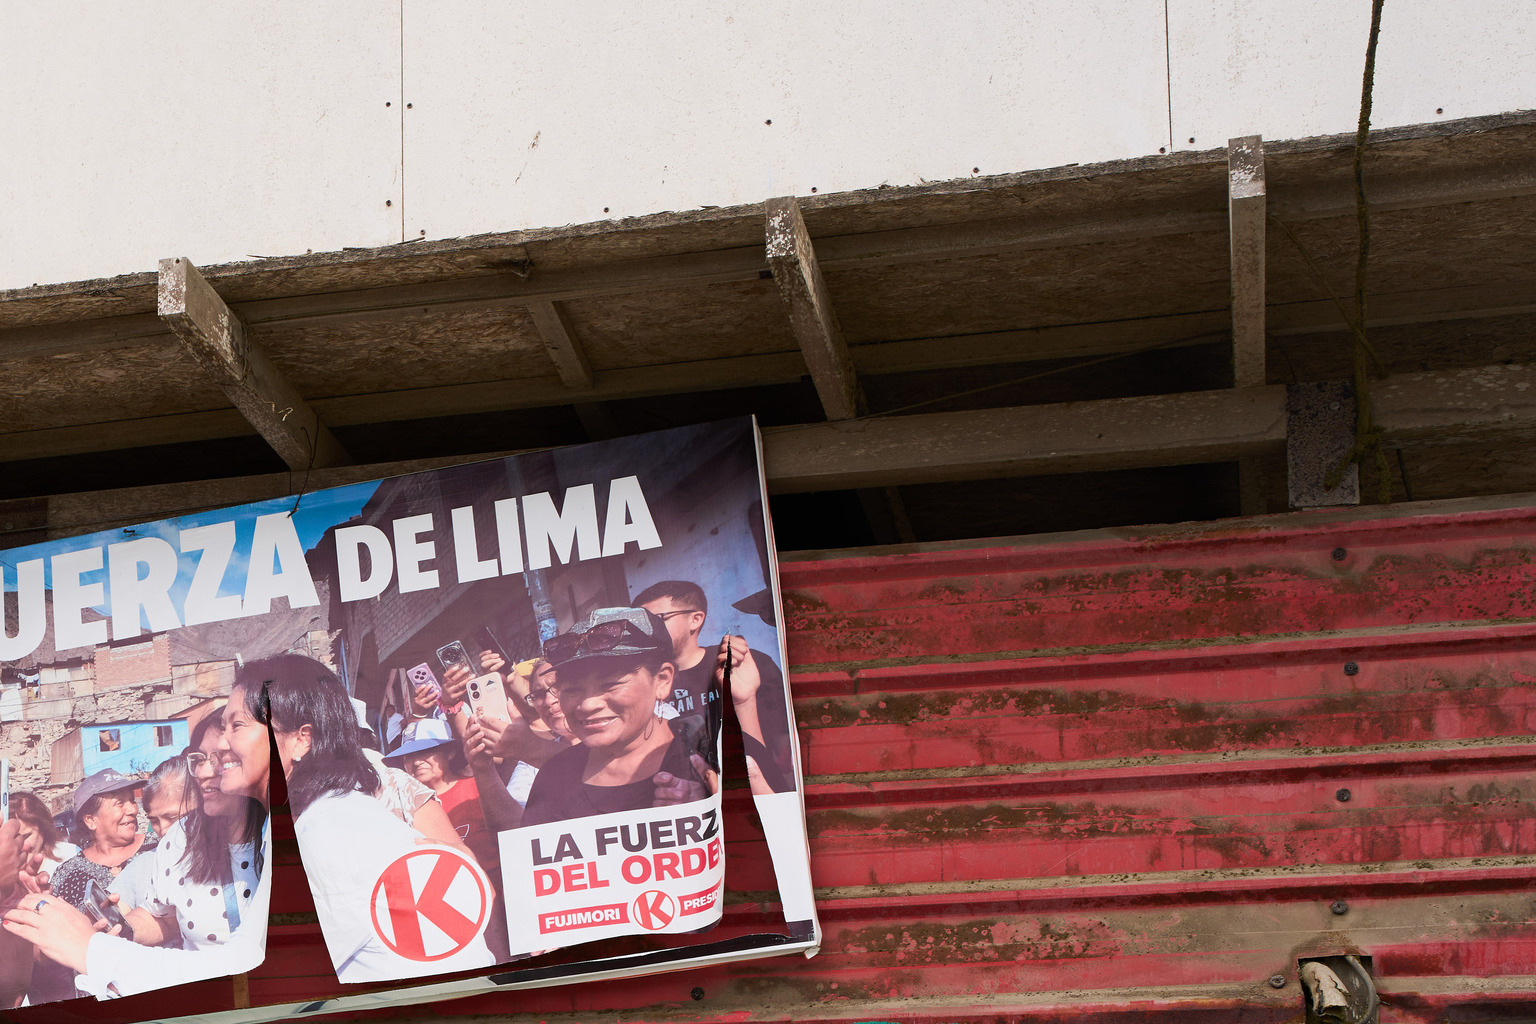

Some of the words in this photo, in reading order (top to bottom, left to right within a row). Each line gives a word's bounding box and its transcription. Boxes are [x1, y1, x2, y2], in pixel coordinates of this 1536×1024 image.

[335, 513, 440, 602] DE
[451, 475, 663, 584] LIMA
[530, 832, 584, 867] LA
[594, 807, 720, 857] FUERZ
[533, 861, 610, 898] DEL
[544, 907, 621, 929] FUJIMORI
